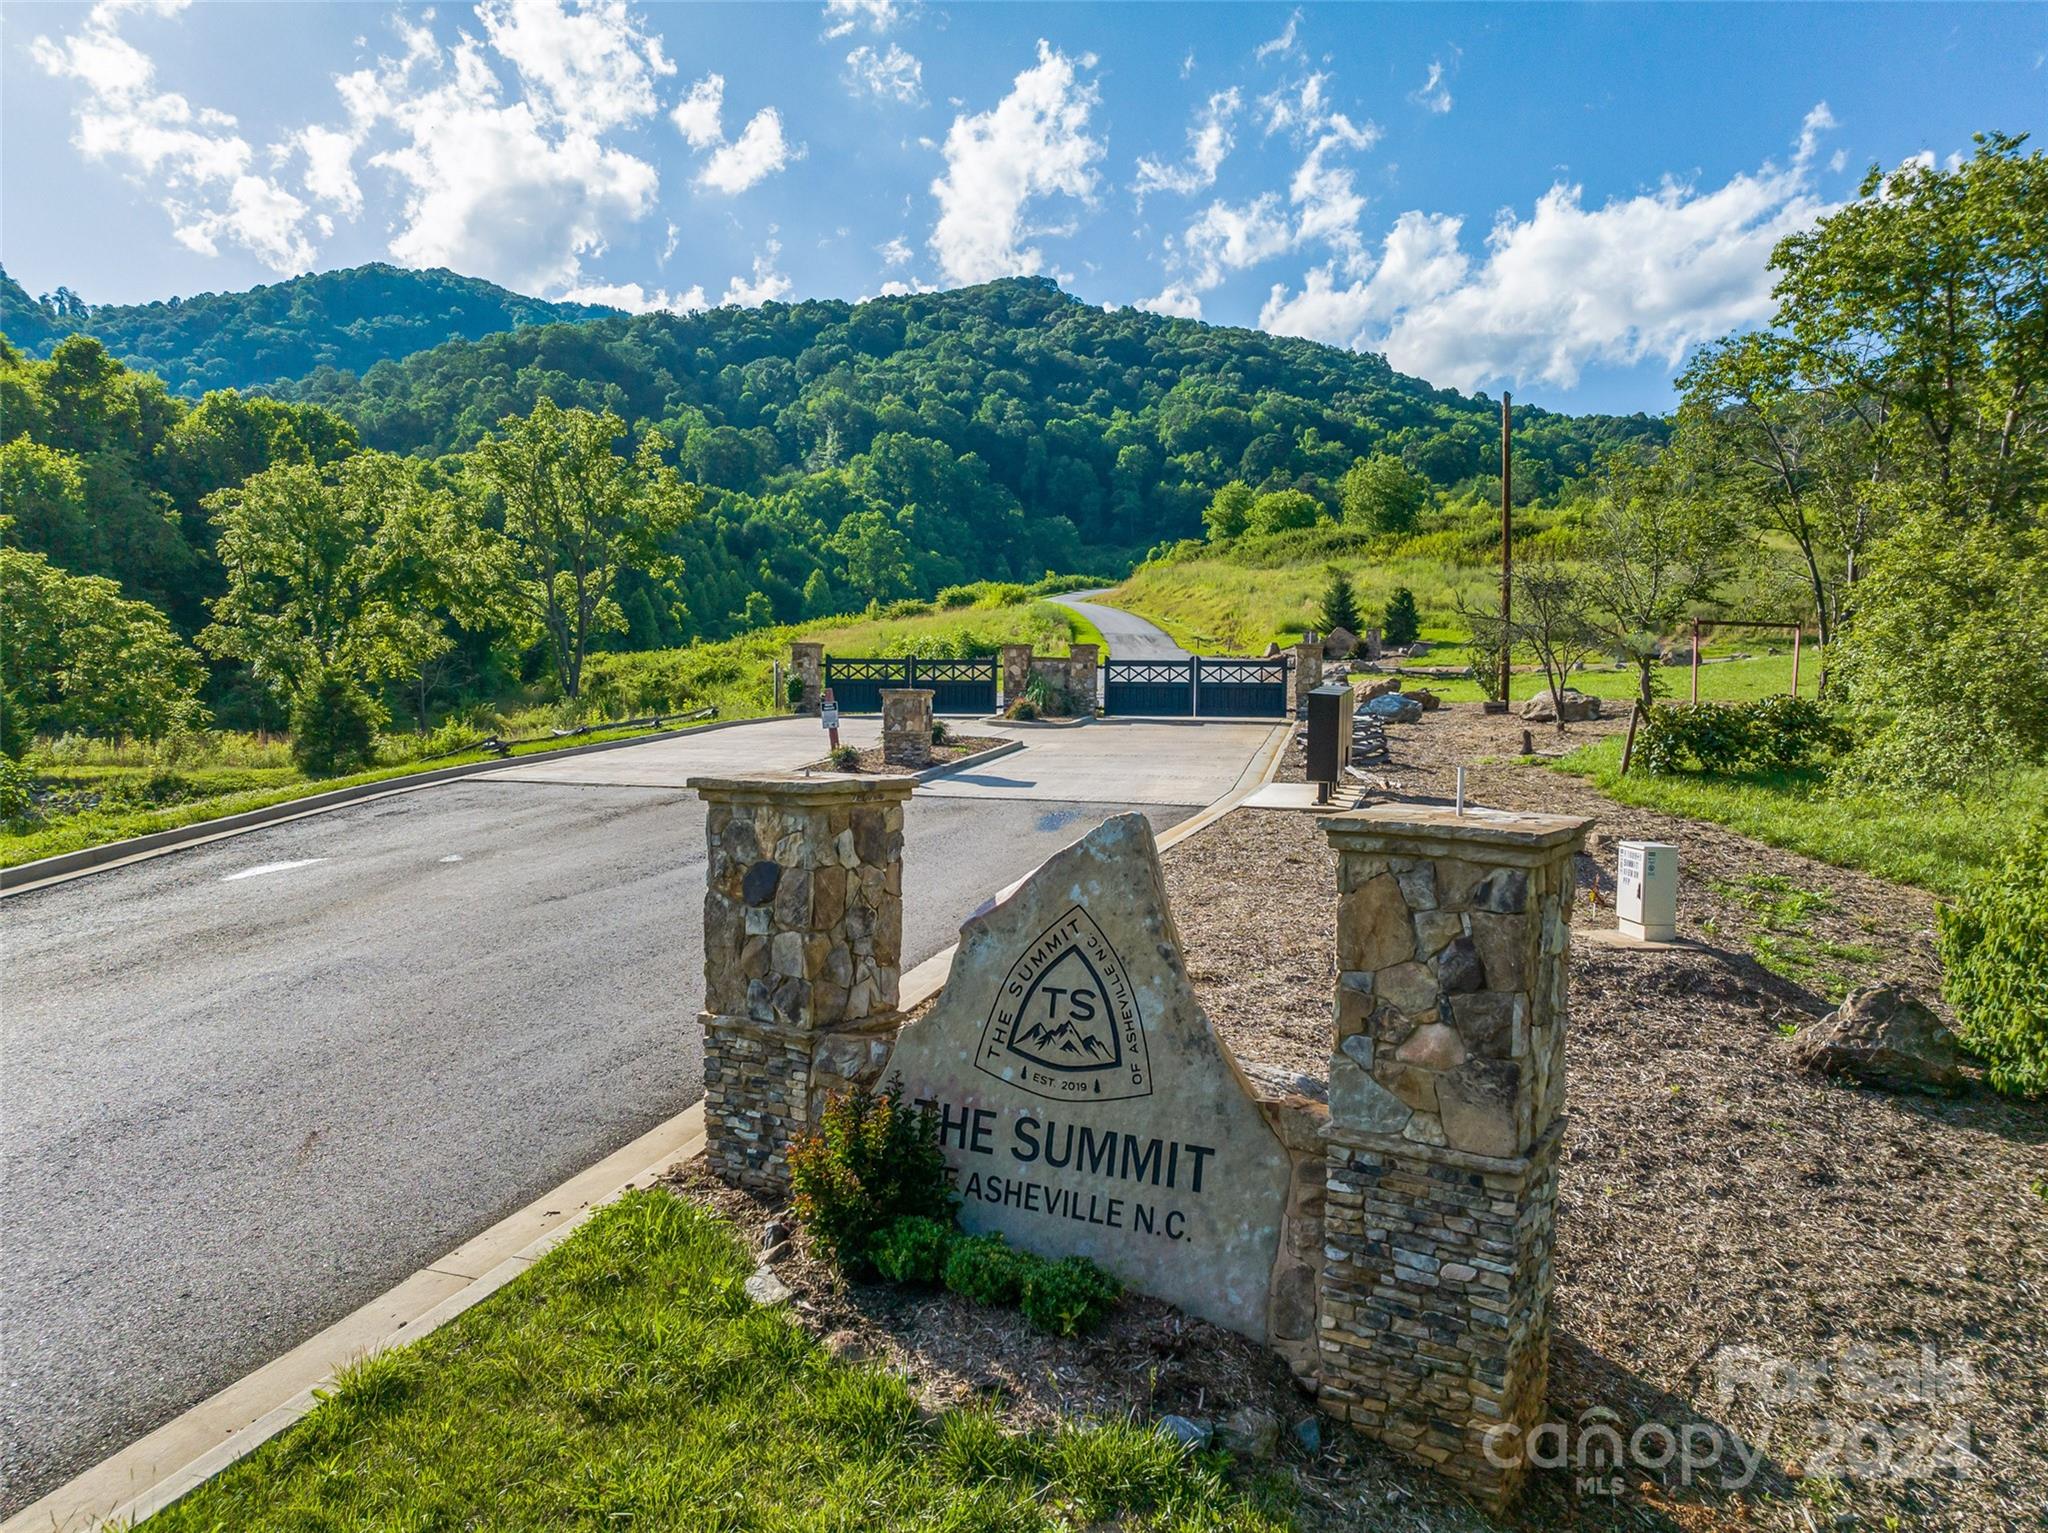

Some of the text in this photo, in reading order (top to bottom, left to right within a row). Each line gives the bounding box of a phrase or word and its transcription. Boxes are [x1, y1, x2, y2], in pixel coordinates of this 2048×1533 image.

[987, 918, 1080, 1059] THE SUMMIT
[1041, 986, 1097, 1022] TS
[1104, 963, 1138, 1053] ASHEVILLE
[1061, 1080, 1088, 1092] 2019
[1130, 1063, 1142, 1085] OF
[1010, 1116, 1216, 1193] SUMMIT
[964, 1172, 1124, 1228] ASHEVILLE
[1133, 1203, 1192, 1243] N.C.
